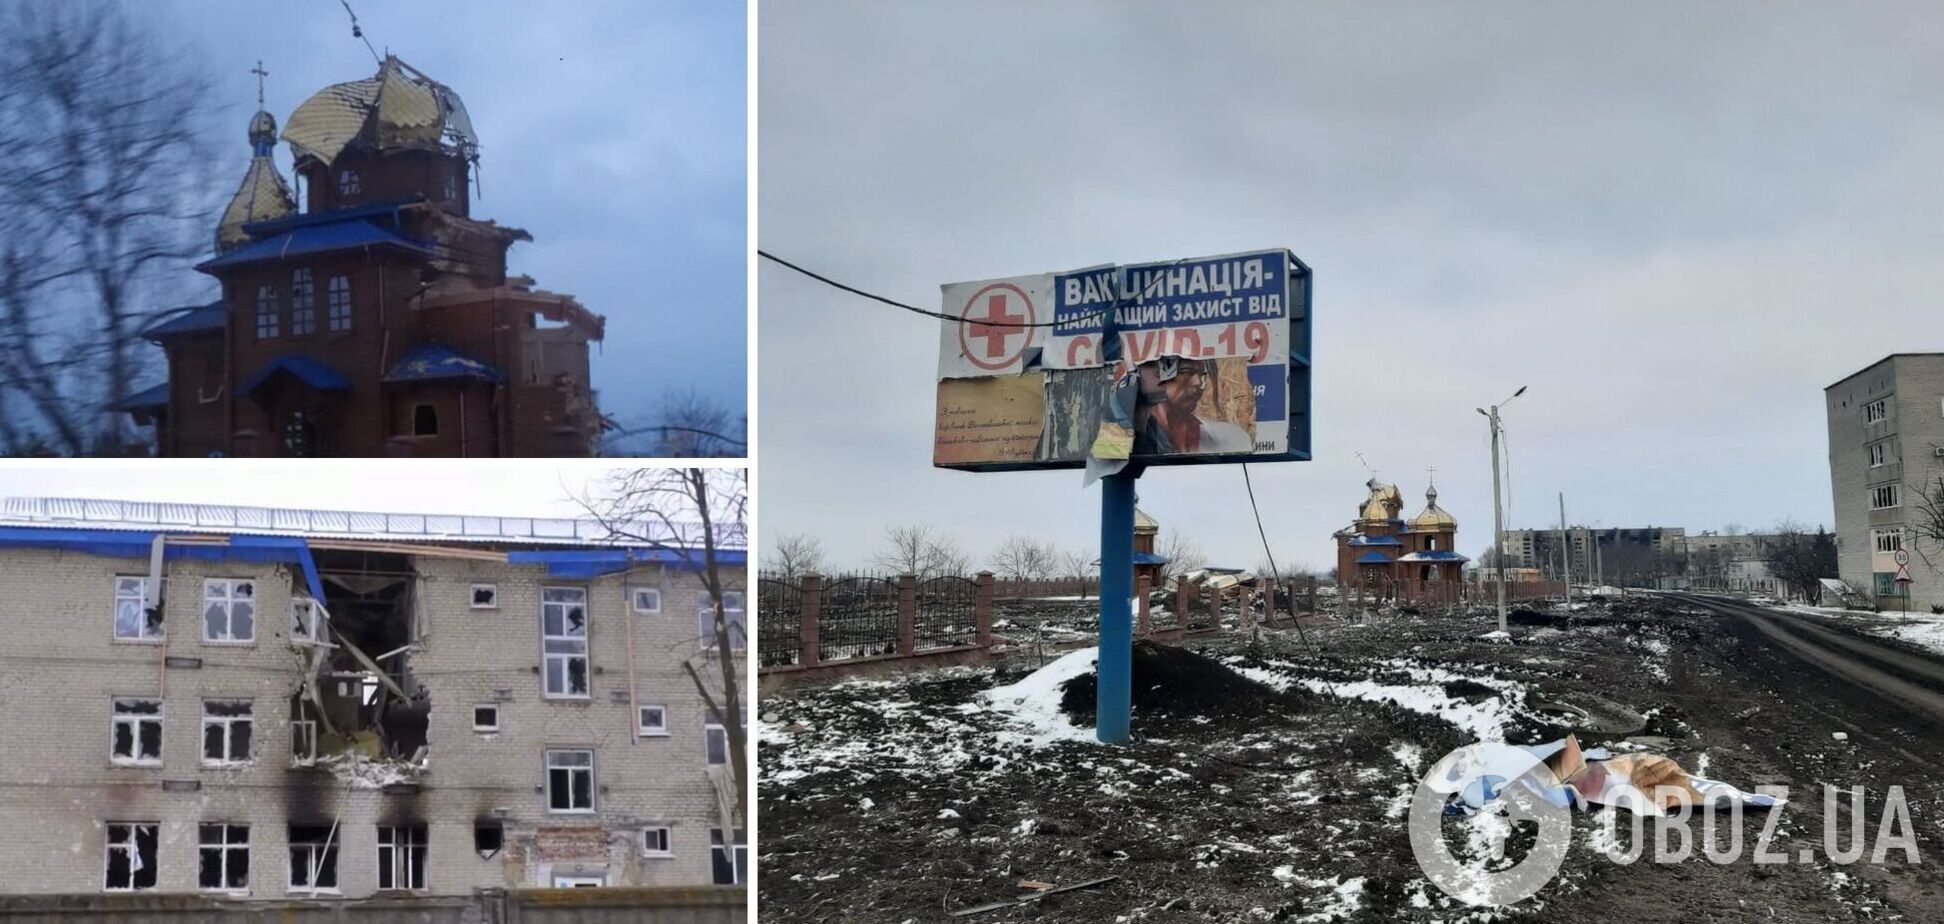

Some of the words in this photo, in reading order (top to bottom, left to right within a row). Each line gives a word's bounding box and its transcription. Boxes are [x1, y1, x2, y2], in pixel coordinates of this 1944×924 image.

[1057, 301, 1167, 331] НАЙКАЩИЙ
[1172, 297, 1243, 321] ЗАХИСТ
[1248, 294, 1281, 316] ВІД
